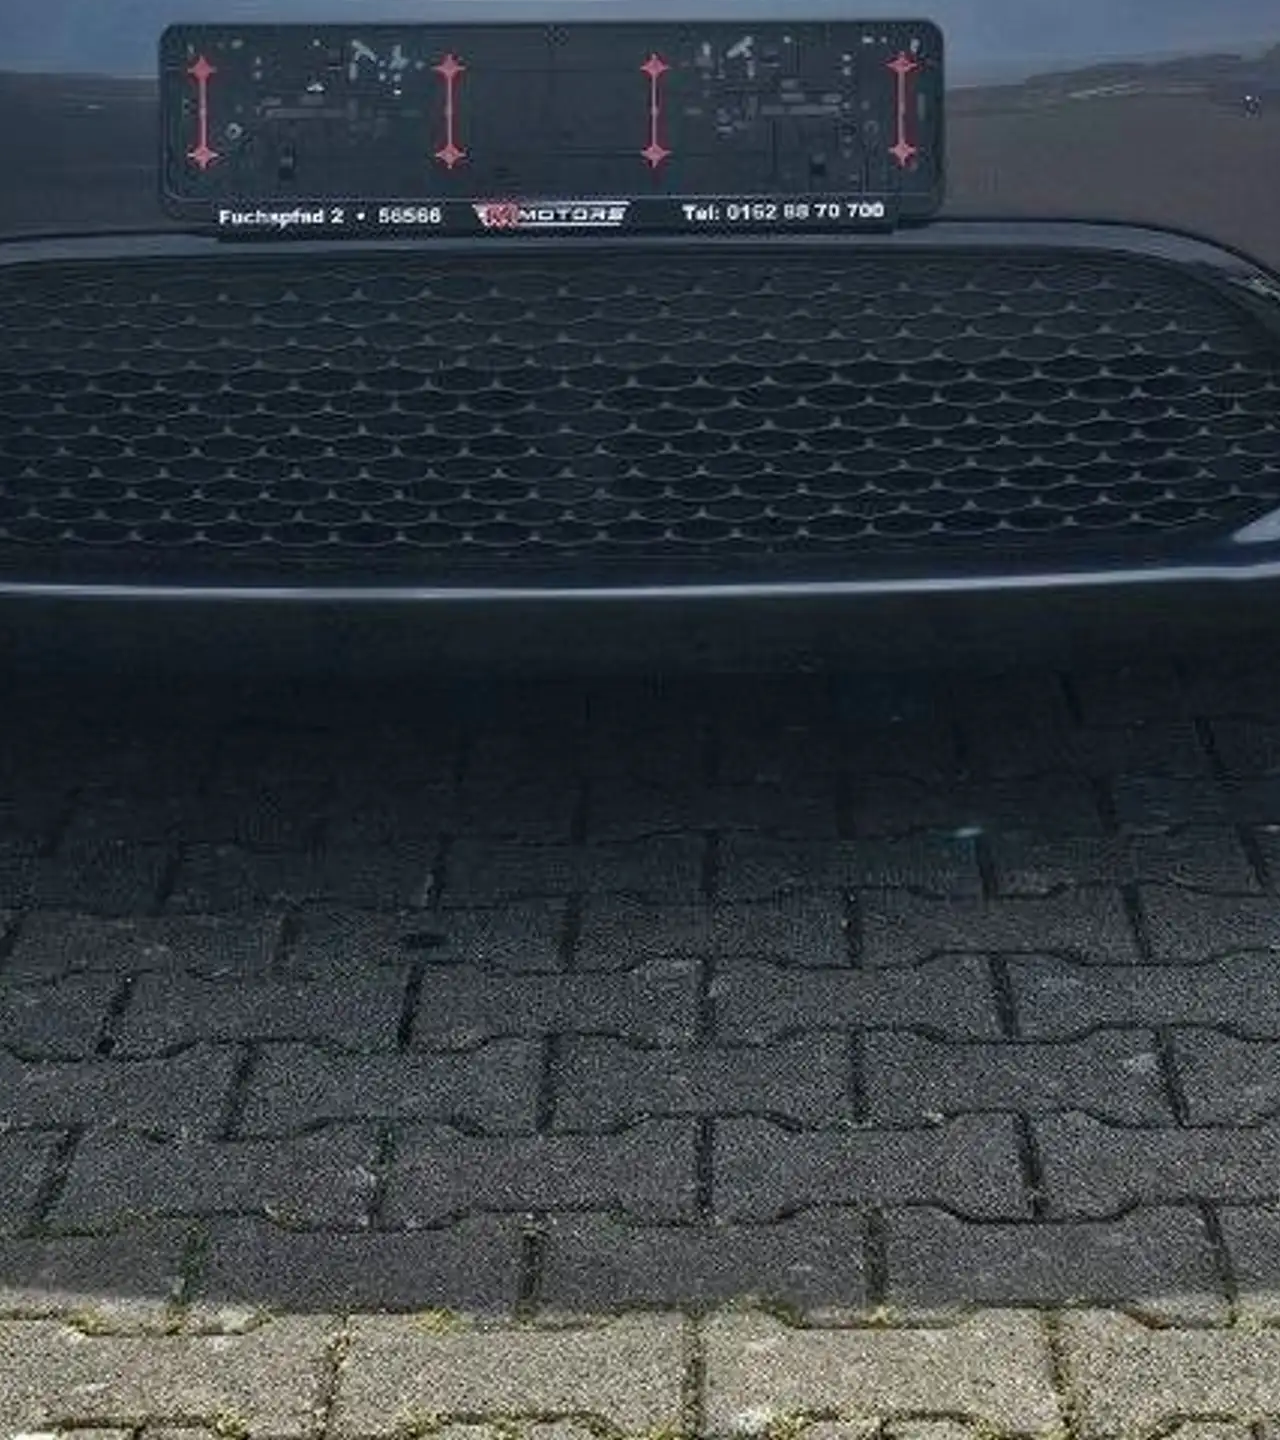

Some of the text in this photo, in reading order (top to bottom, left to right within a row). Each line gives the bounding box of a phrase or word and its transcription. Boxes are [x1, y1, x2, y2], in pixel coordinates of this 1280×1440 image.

[218, 206, 325, 230] Fuchspfad
[331, 207, 345, 224] 2
[519, 206, 627, 221] MOTORS
[682, 201, 885, 220] Tel: 0162 88 70 700
